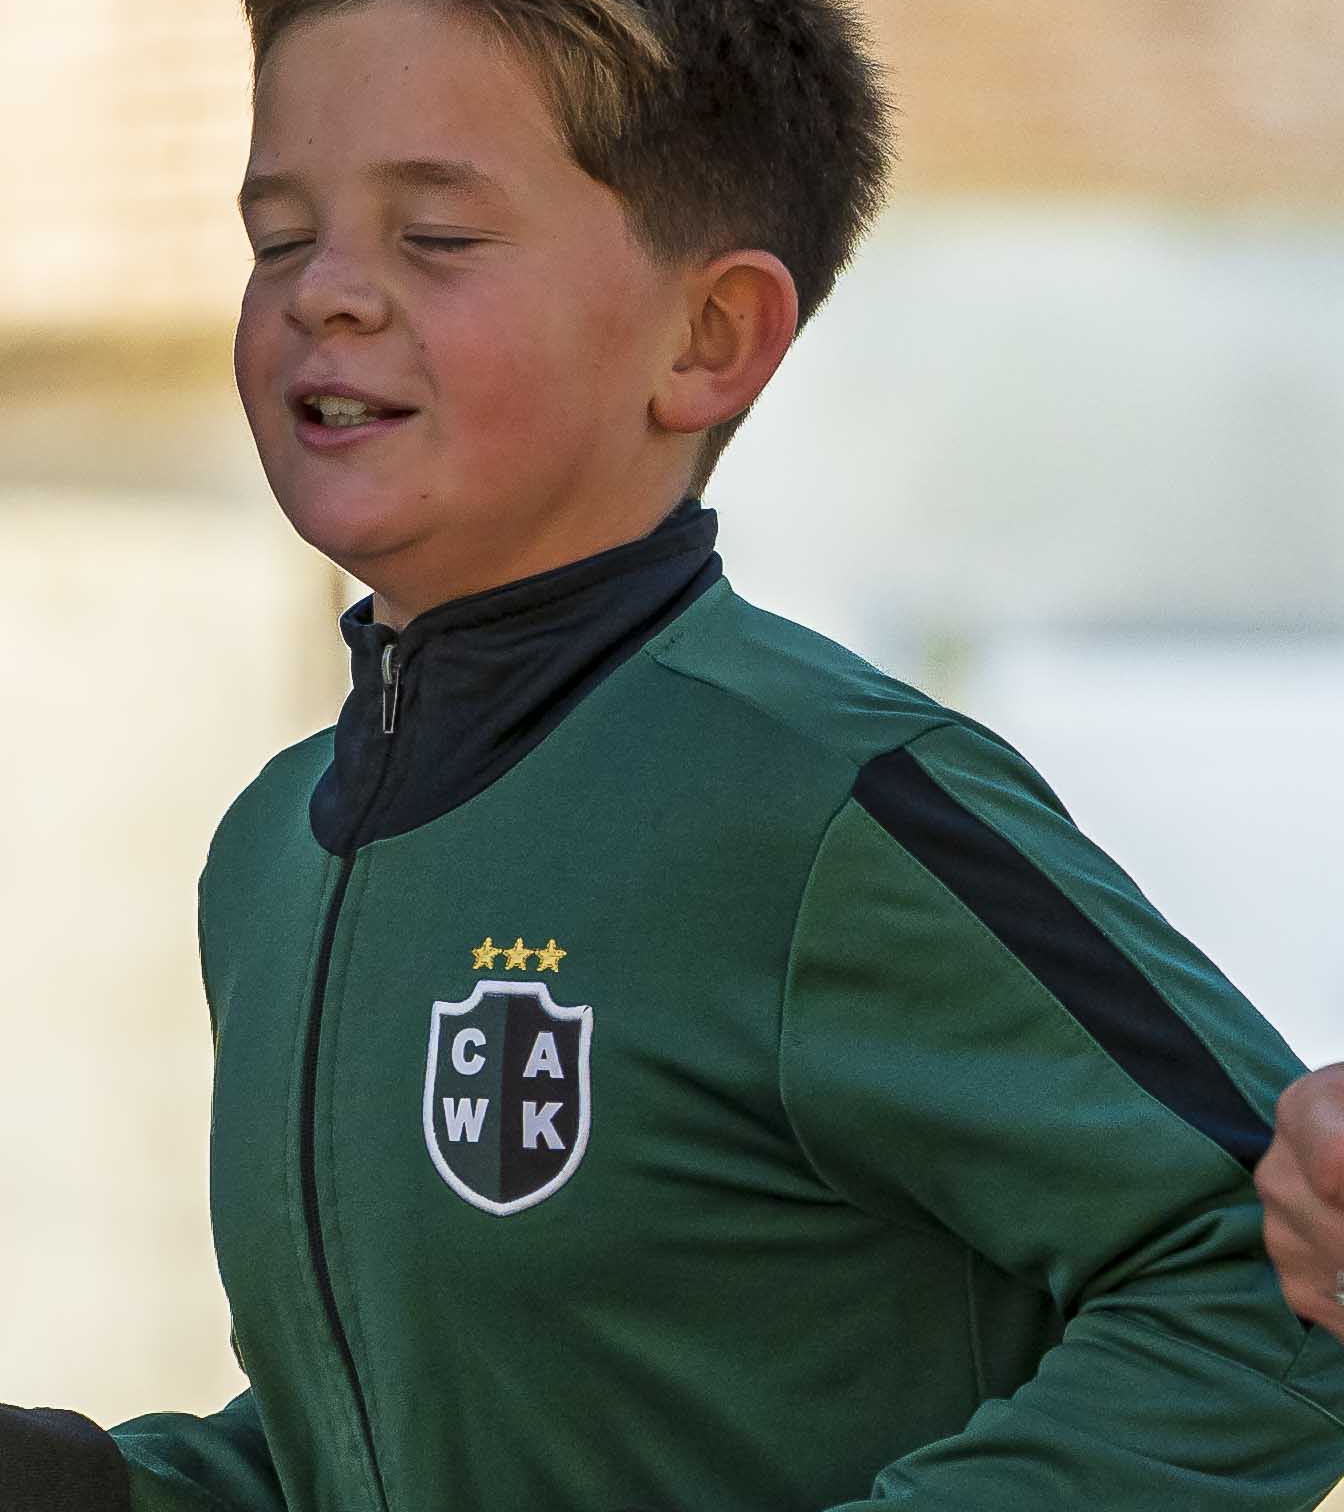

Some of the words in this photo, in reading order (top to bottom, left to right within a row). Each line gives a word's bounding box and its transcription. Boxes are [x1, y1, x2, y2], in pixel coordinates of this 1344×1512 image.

[451, 1027, 487, 1076] C
[522, 1031, 565, 1079] A
[442, 1096, 490, 1143] W
[522, 1100, 567, 1150] K
